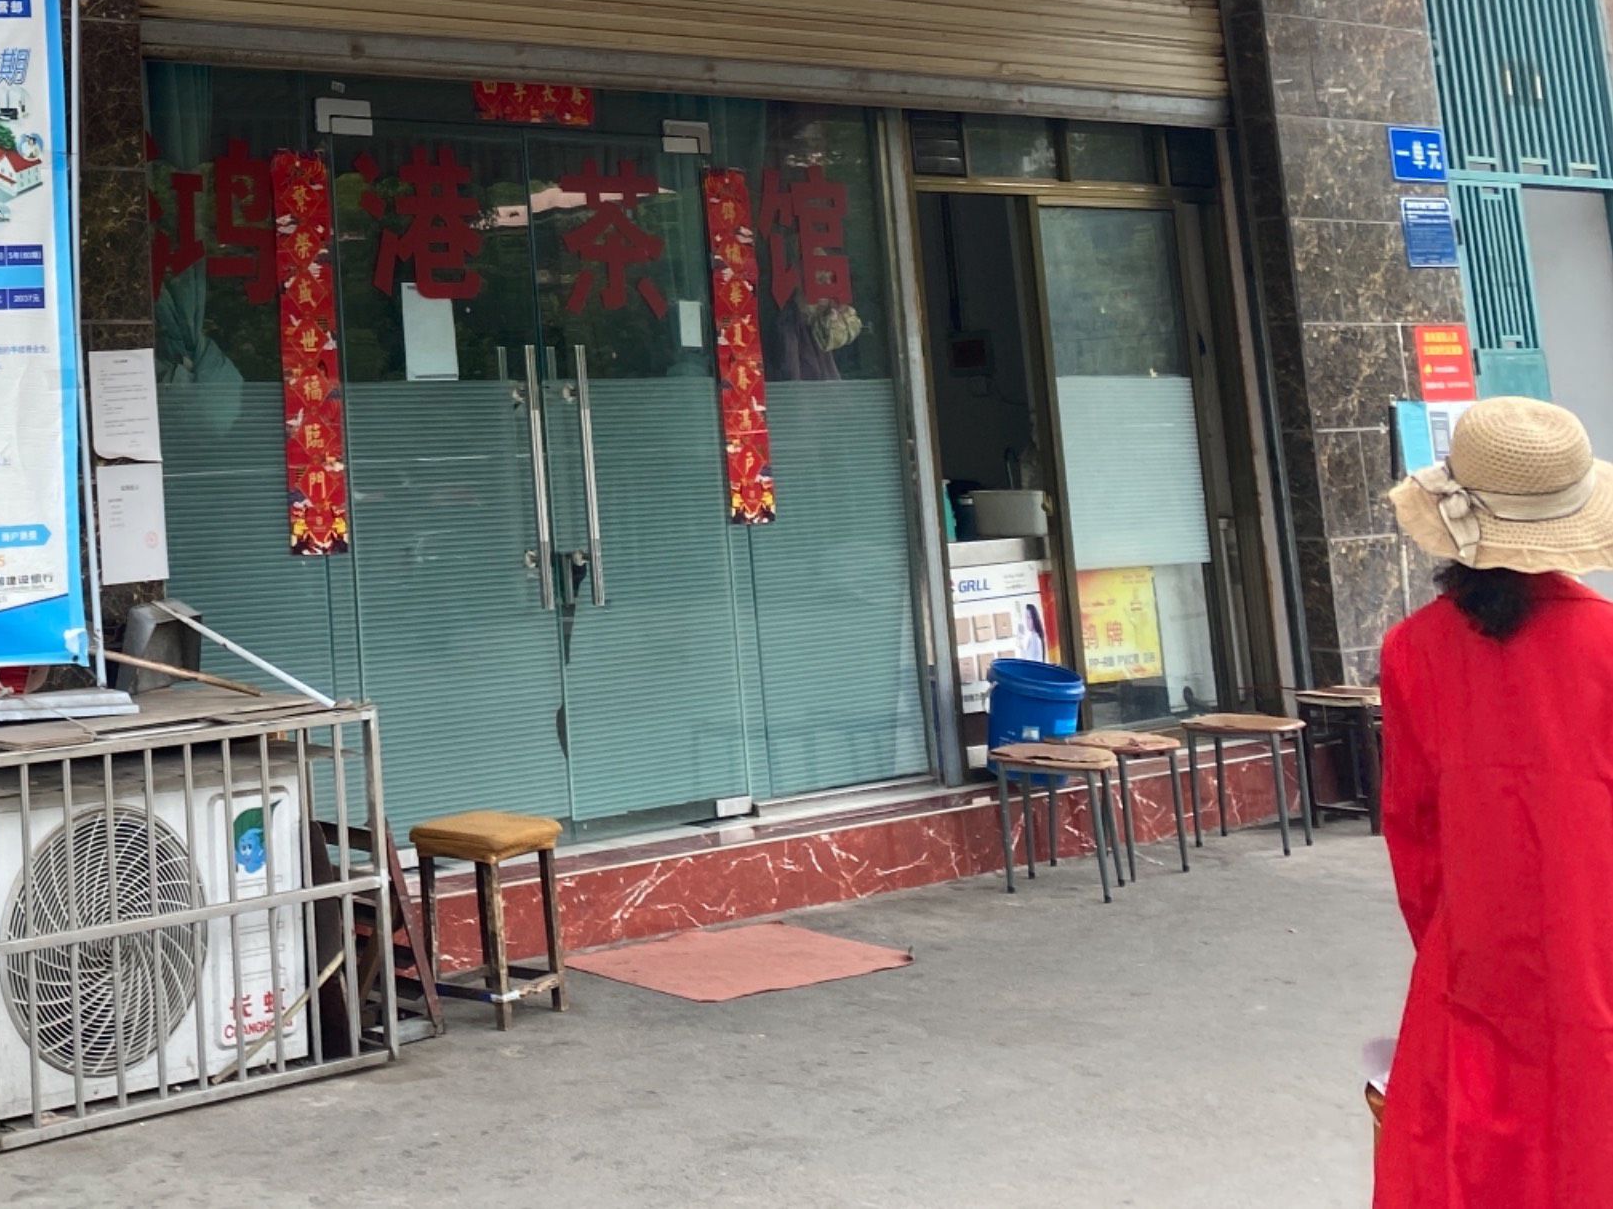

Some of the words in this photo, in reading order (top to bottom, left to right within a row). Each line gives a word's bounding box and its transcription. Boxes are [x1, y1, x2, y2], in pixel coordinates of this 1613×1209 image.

[1395, 140, 1441, 170] 一单元
[146, 136, 853, 320] 鸿港茶馆
